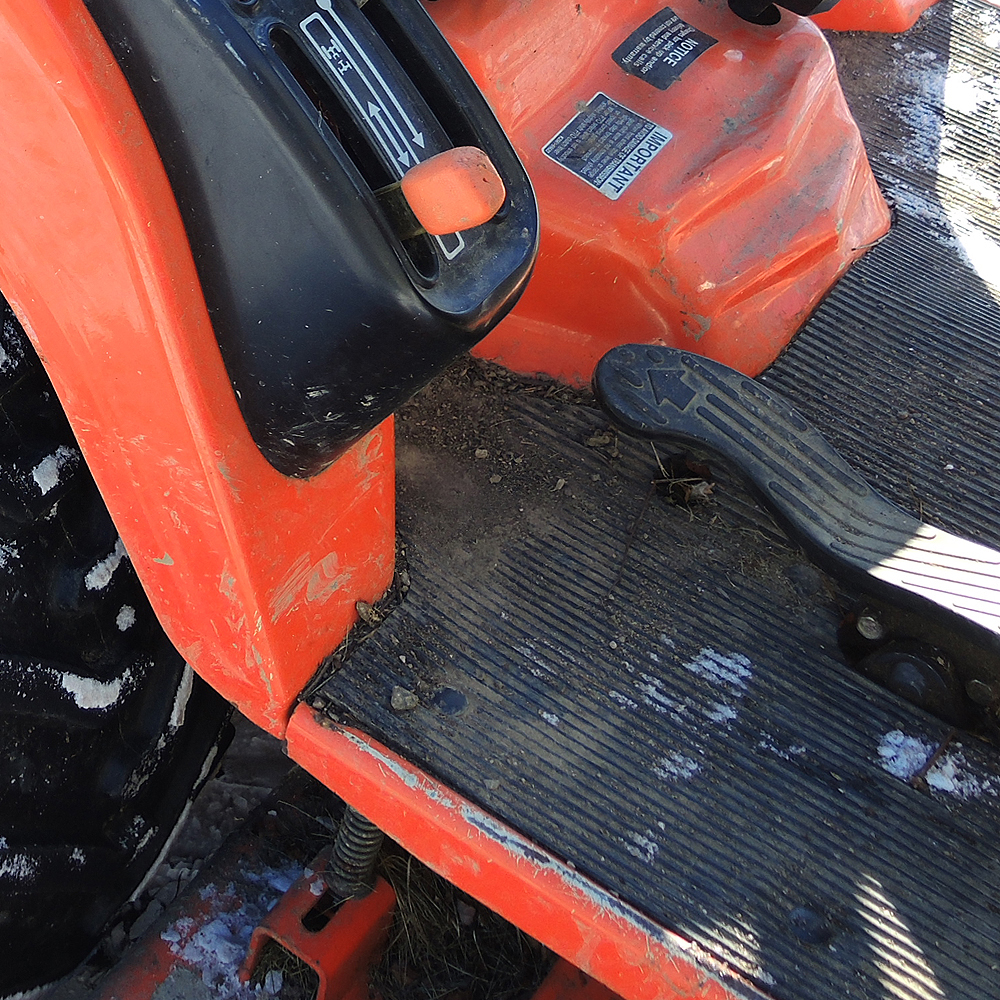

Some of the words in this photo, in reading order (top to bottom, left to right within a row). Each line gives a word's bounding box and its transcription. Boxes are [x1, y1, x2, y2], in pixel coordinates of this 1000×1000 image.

[661, 31, 671, 39] and
[621, 42, 644, 63] warranty.
[645, 38, 663, 54] service
[662, 39, 673, 50] pick
[662, 37, 698, 67] NOTICE
[633, 53, 647, 66] calls
[640, 56, 657, 73] and/or
[607, 130, 667, 192] IMPORTANT
